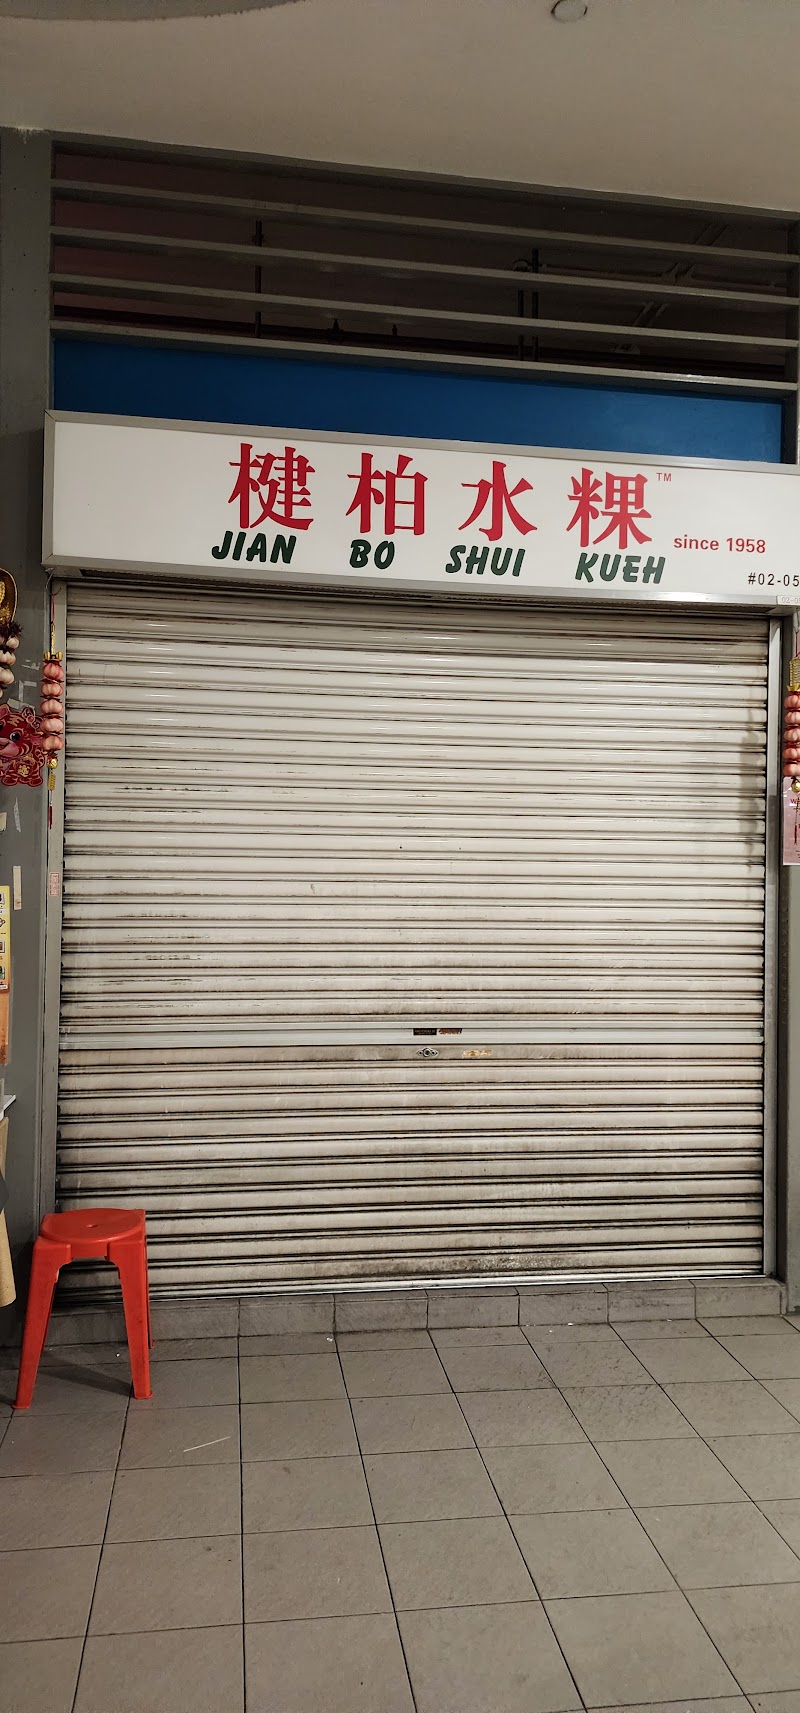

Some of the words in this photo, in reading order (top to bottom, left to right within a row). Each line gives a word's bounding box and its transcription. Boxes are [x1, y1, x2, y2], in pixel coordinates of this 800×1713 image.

[228, 442, 652, 550] 楗柏水粿
[673, 534, 720, 551] since
[726, 537, 767, 554] 1958
[211, 530, 297, 565] JIAN
[349, 538, 396, 570] BO
[445, 544, 526, 577] SHUI
[574, 552, 666, 584] KUEH
[747, 572, 800, 587] #02-05
[781, 596, 800, 604] 02-0
